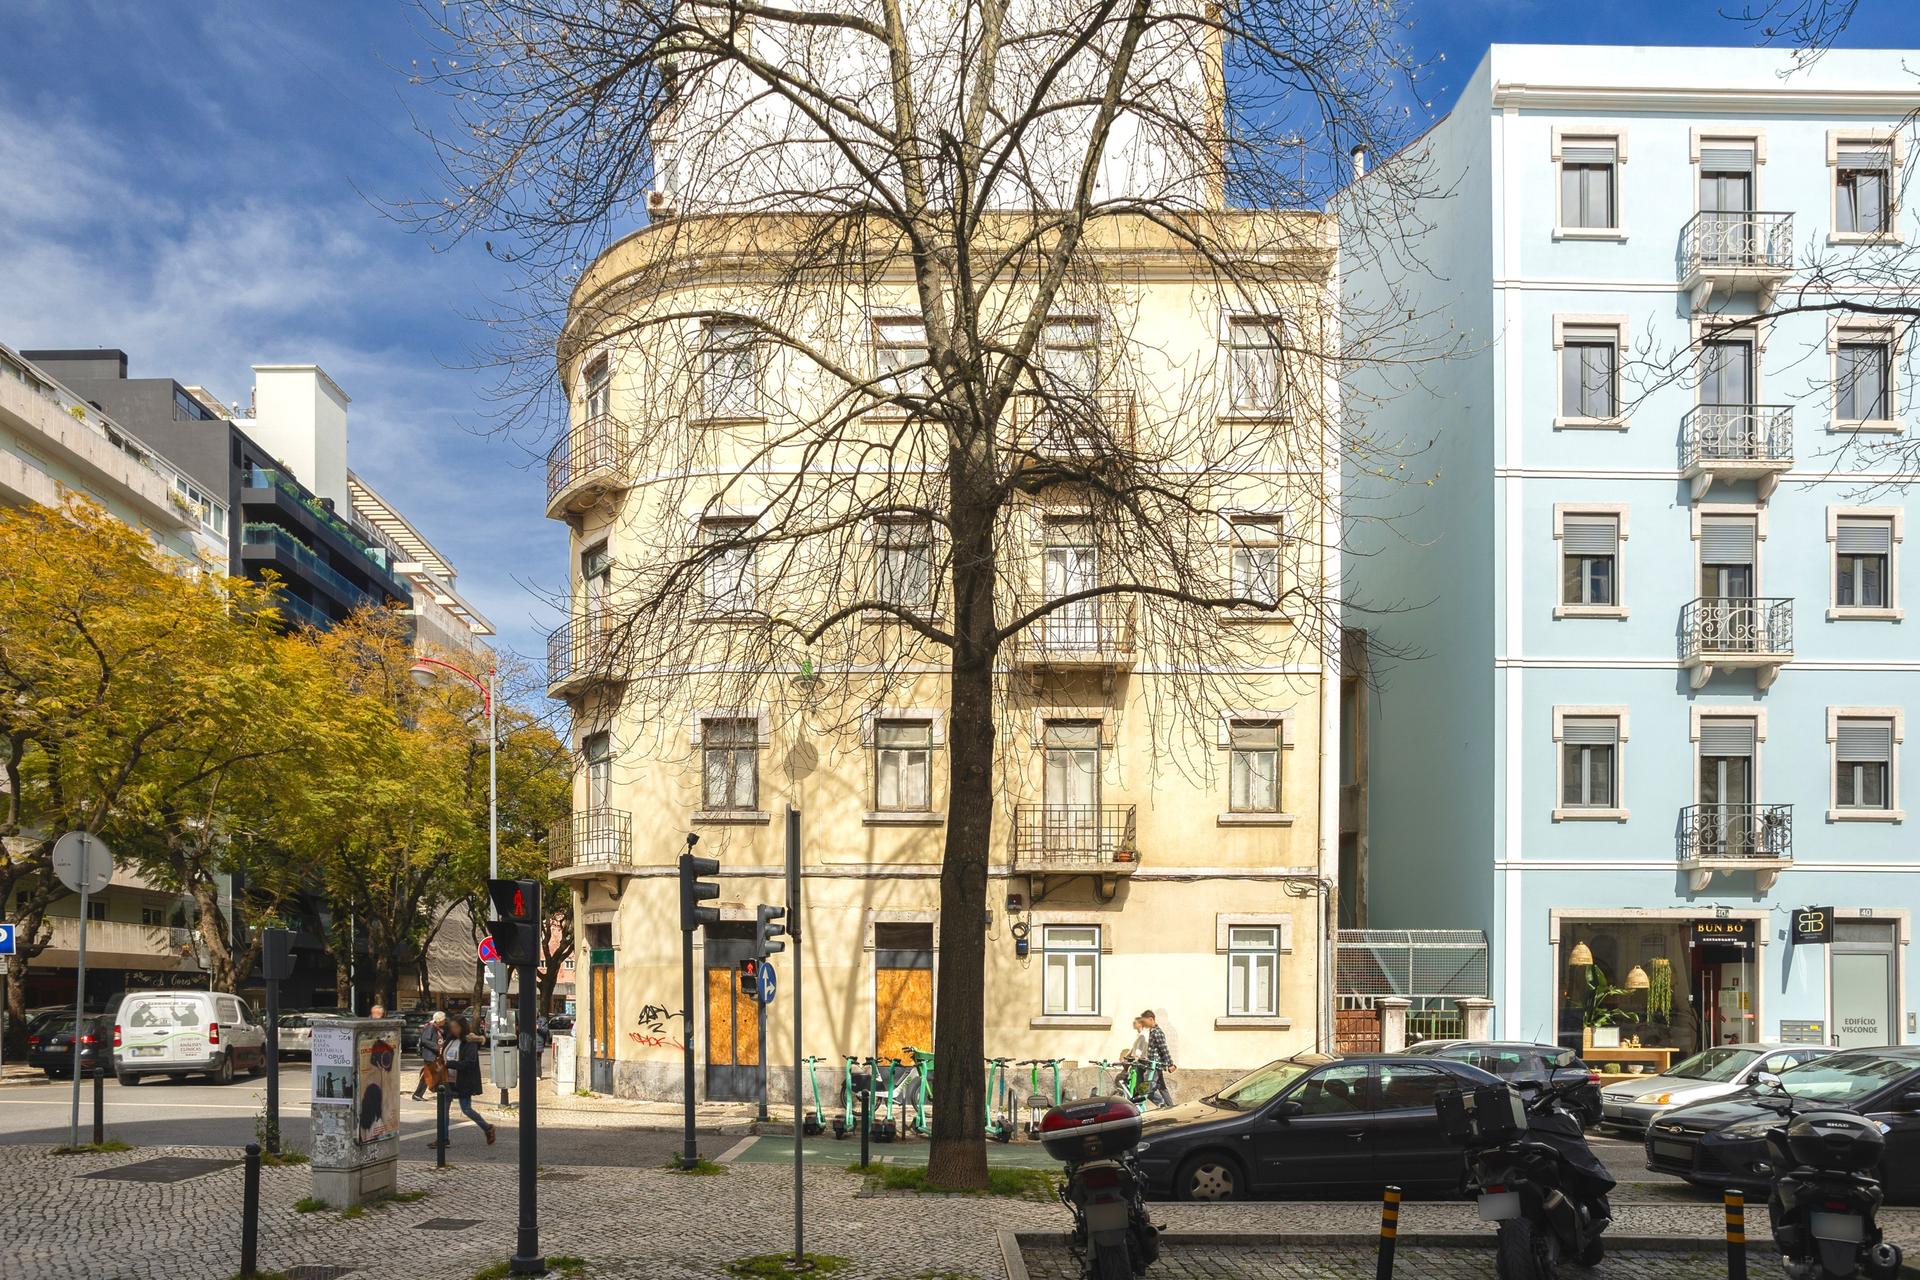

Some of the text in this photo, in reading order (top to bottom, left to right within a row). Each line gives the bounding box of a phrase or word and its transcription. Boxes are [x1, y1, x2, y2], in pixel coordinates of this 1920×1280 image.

[1698, 924, 1743, 932] BUN BO
[1844, 1017, 1876, 1025] EDIFÍCIO
